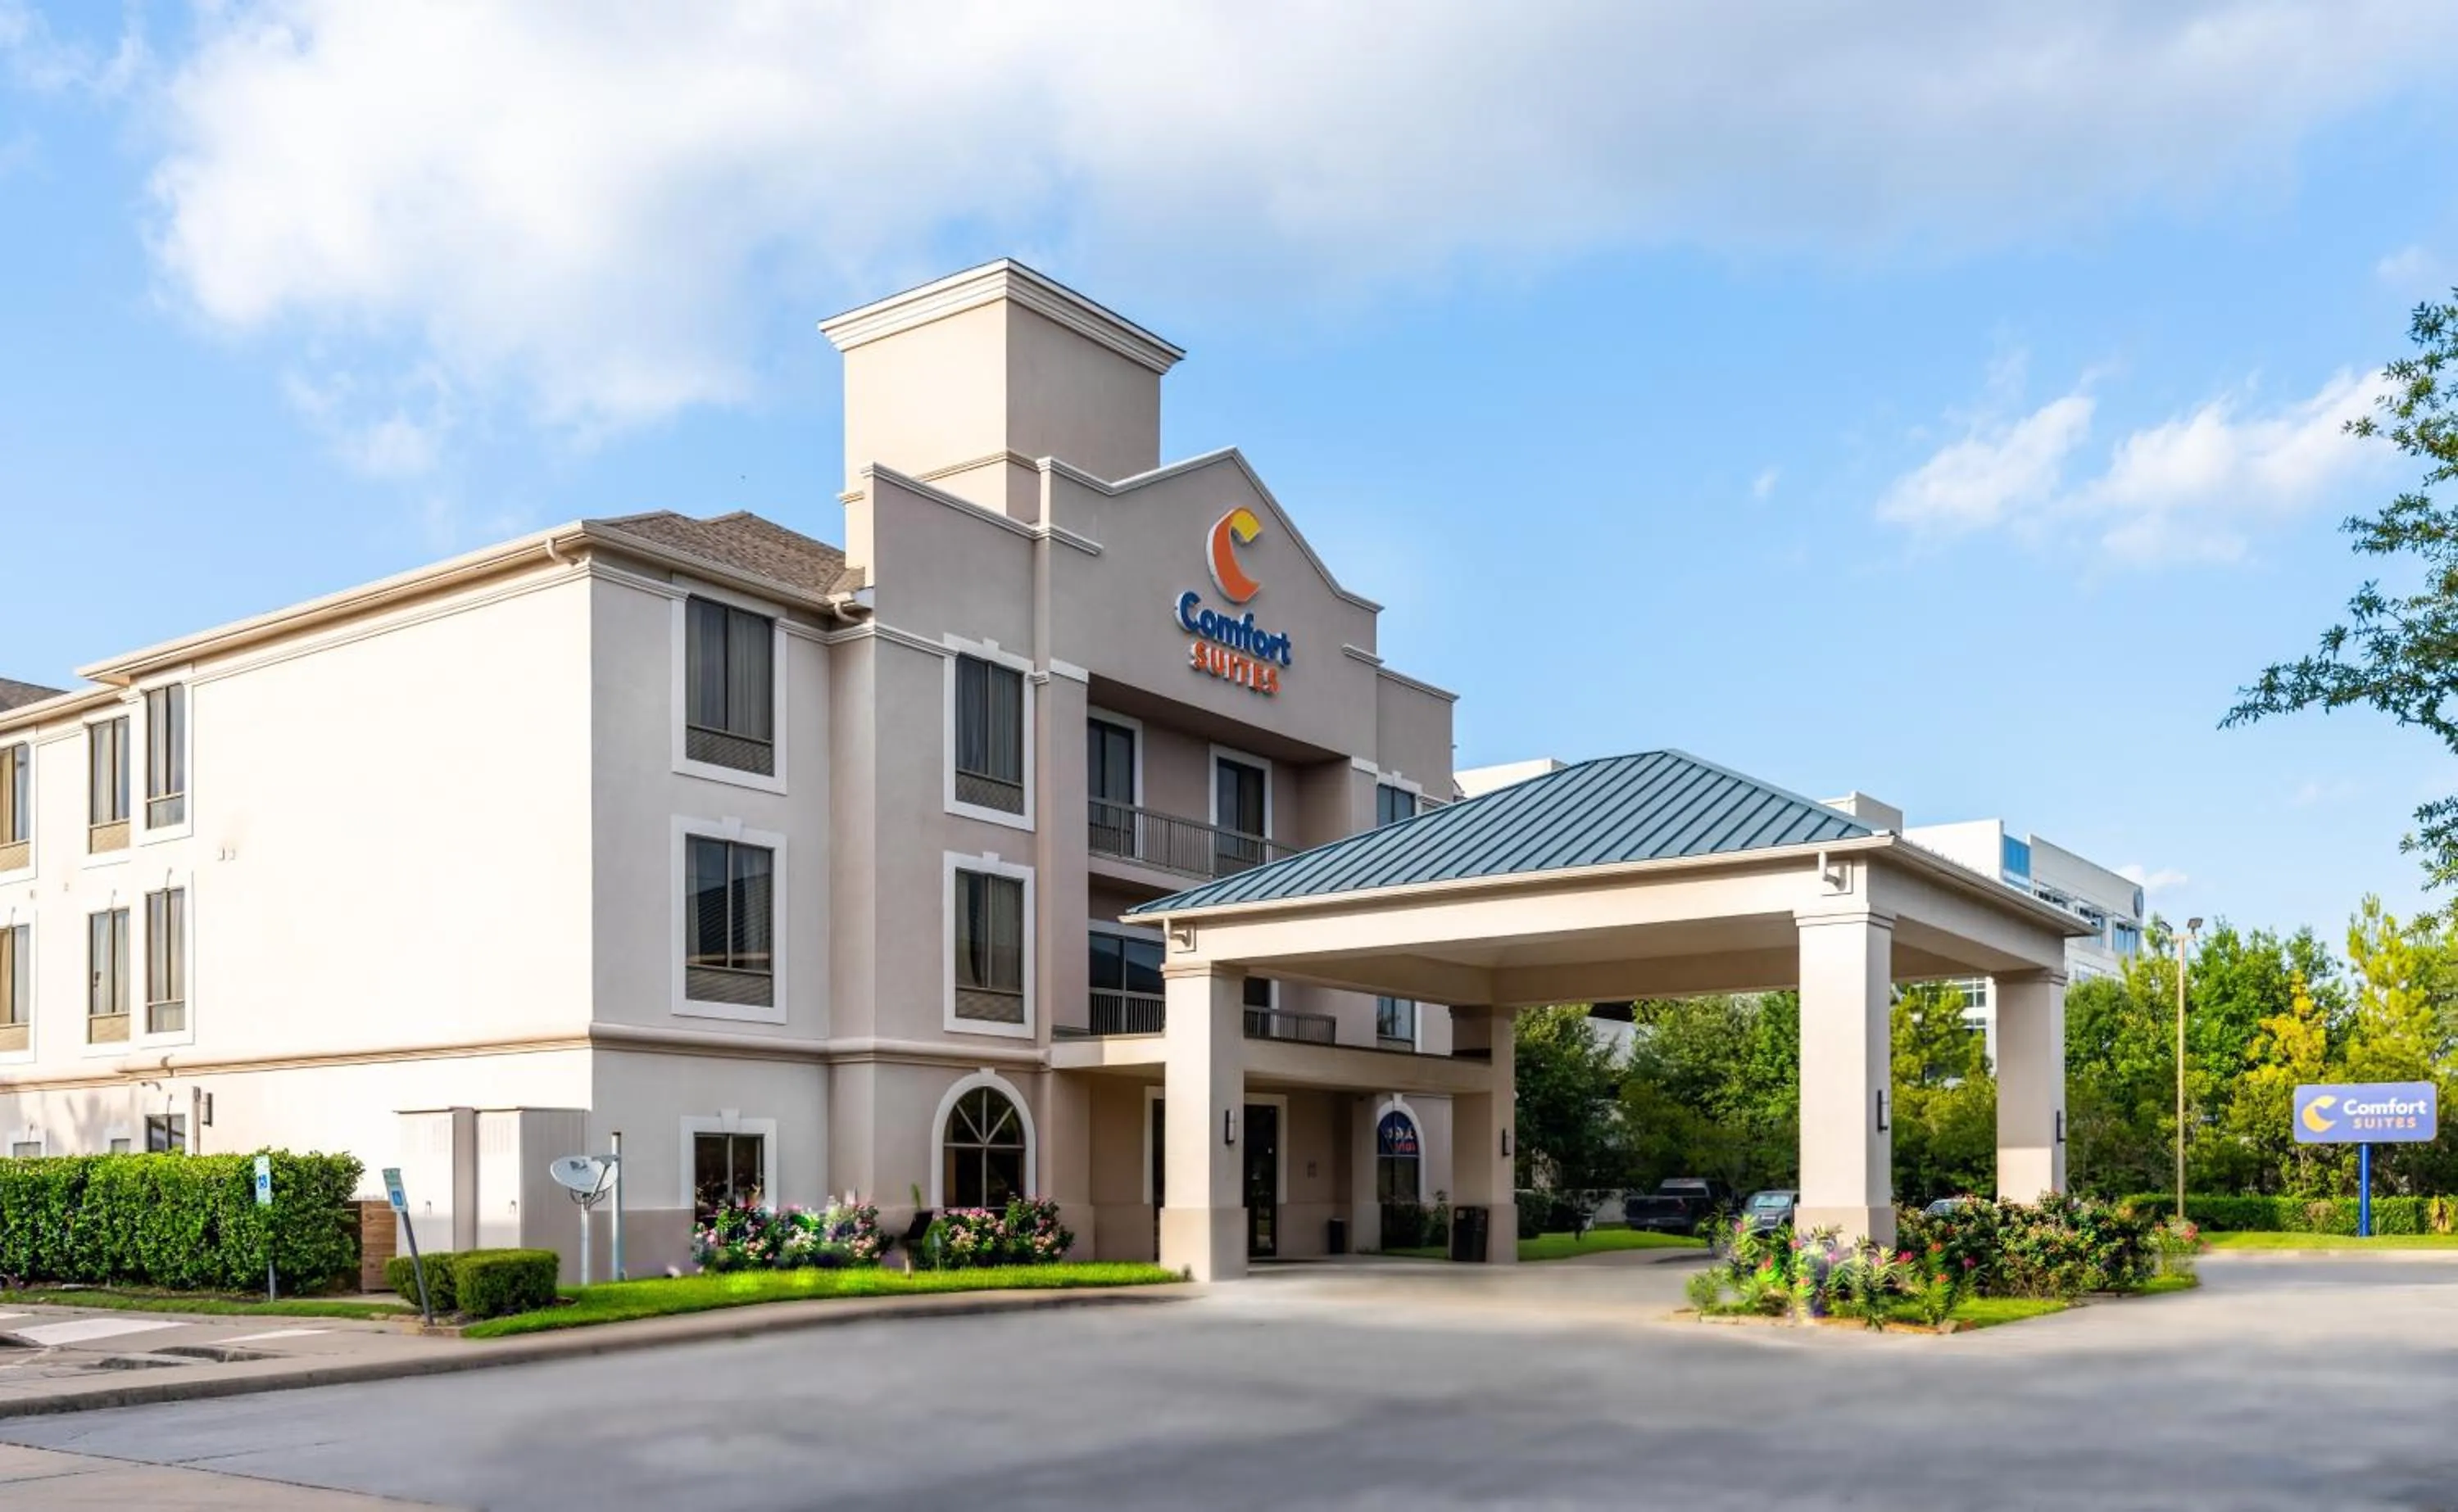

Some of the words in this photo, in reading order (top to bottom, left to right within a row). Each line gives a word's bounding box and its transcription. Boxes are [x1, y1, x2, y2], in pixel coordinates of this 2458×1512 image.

[1175, 591, 1291, 667] Comfort
[1190, 641, 1281, 695] SUITES
[2343, 1098, 2427, 1116] Comfort
[2353, 1116, 2416, 1129] SUITES
